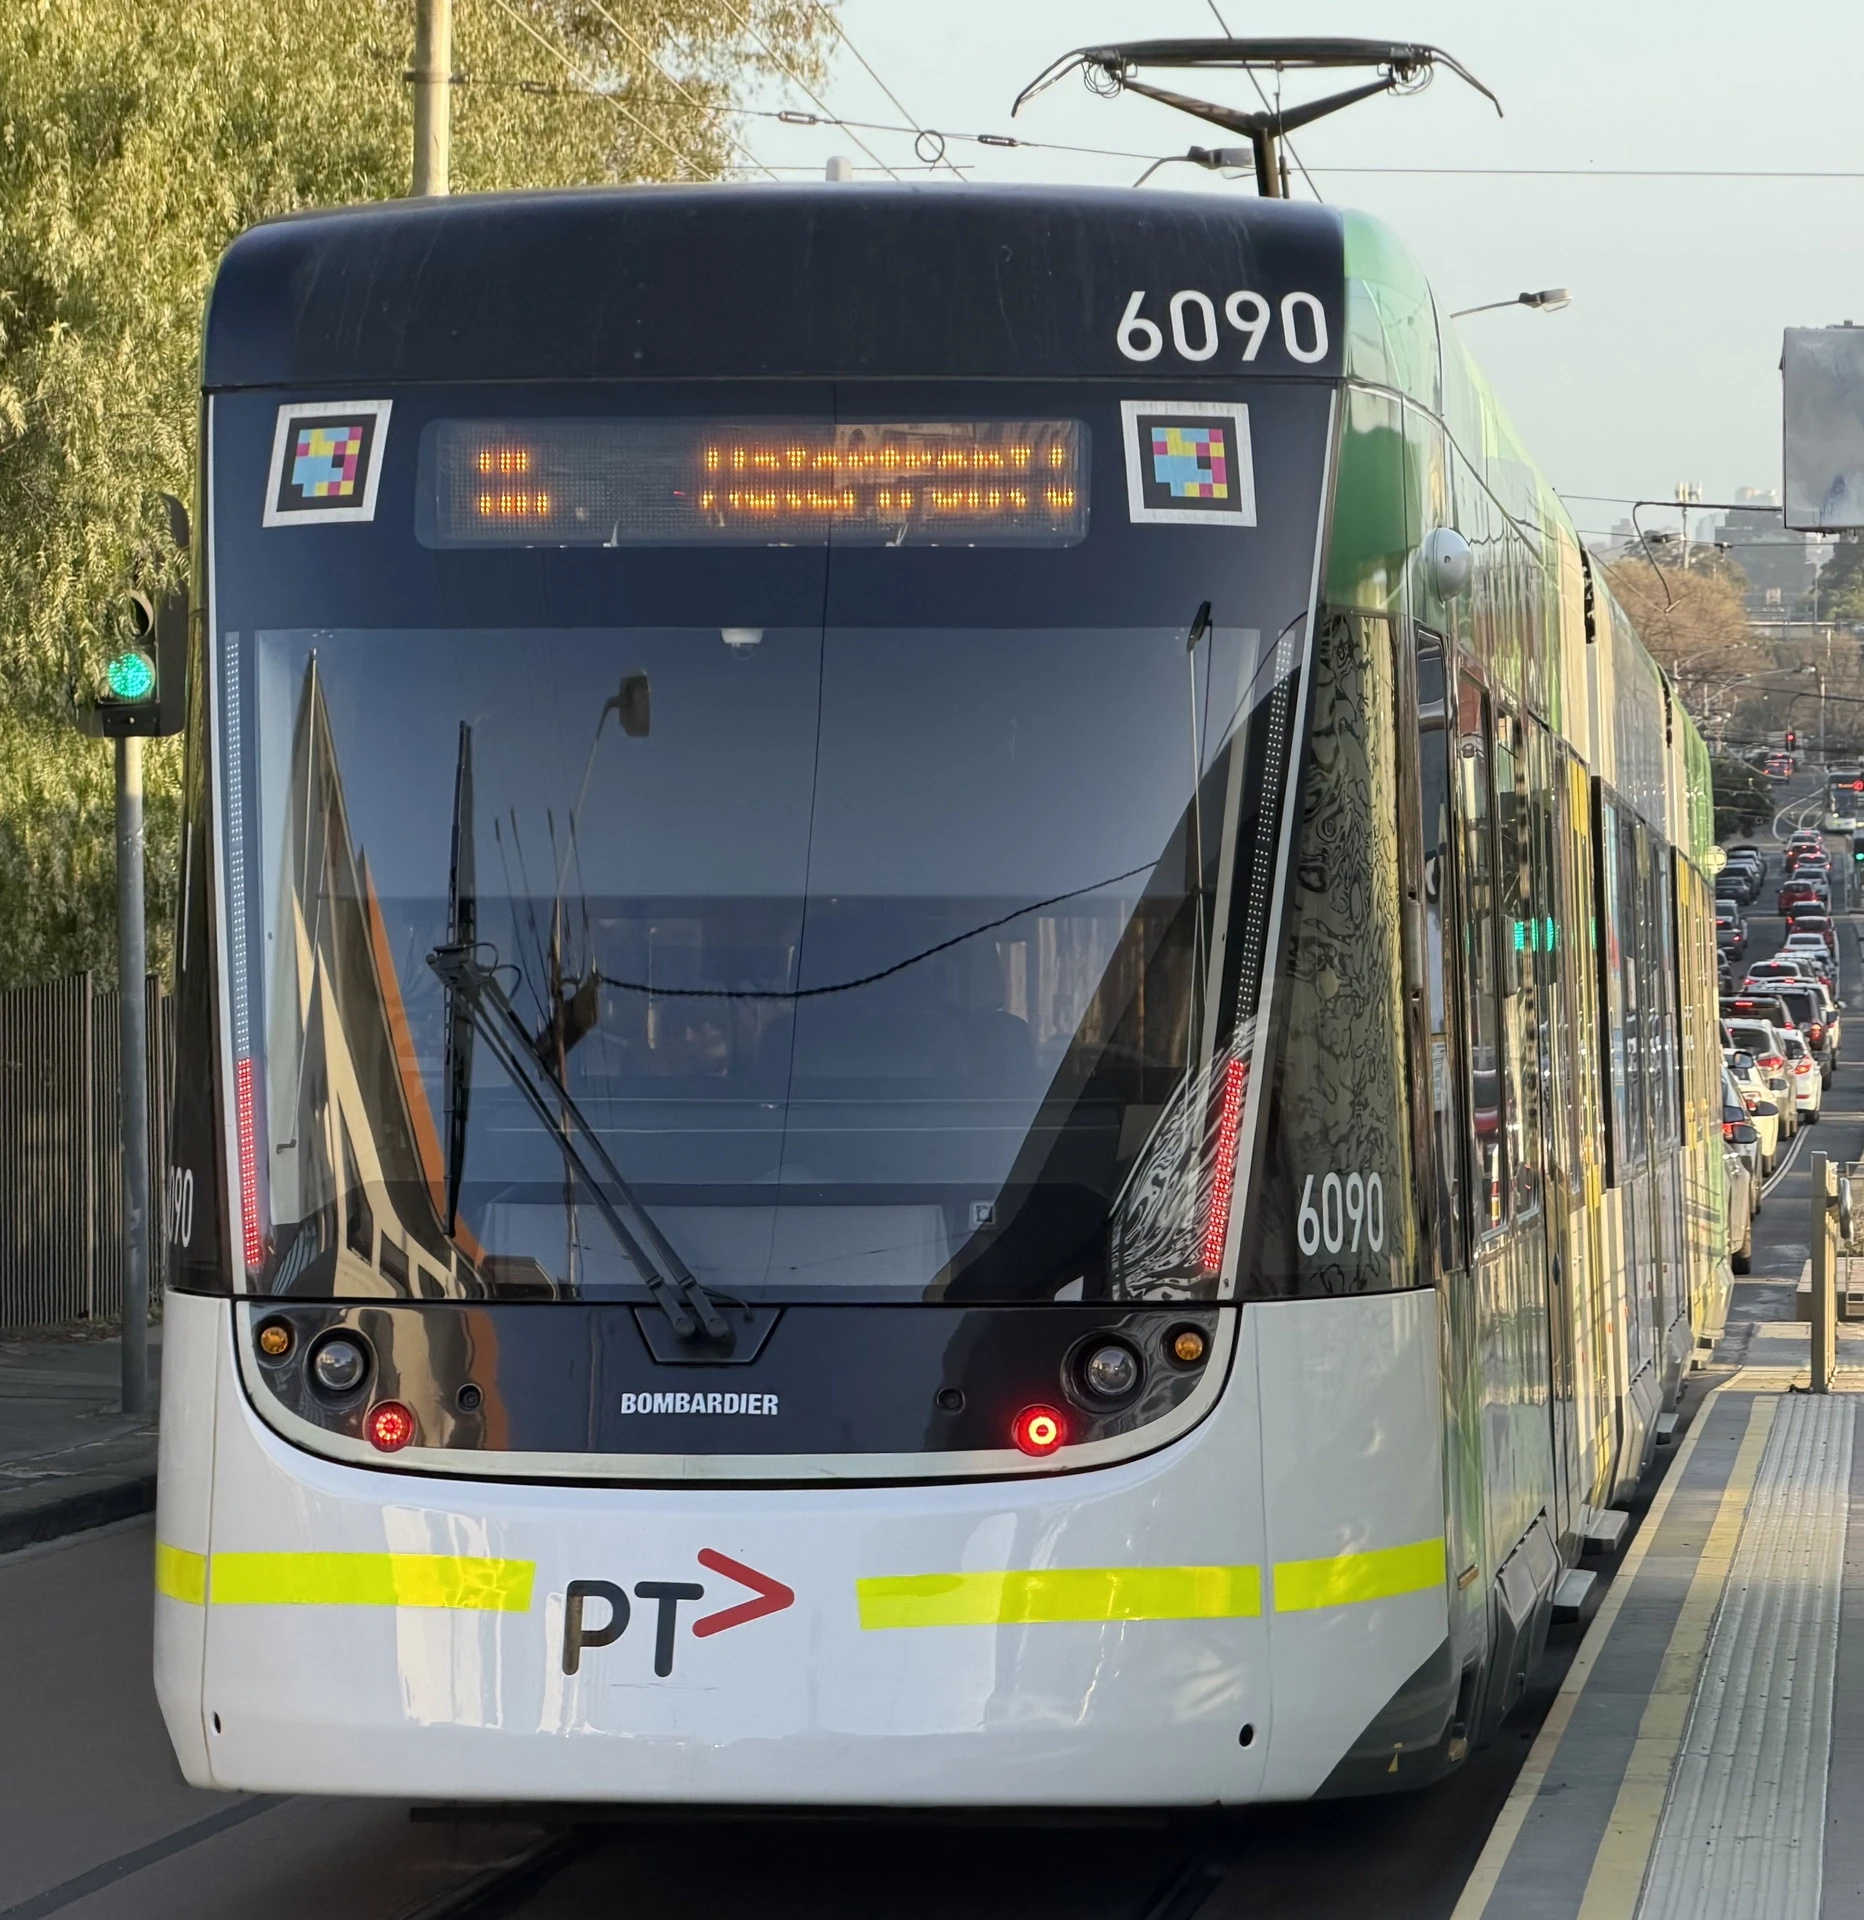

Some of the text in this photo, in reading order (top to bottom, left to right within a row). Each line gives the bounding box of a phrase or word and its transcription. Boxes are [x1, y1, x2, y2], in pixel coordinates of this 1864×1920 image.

[1116, 289, 1329, 364] 6090
[166, 1164, 194, 1248] 090
[1297, 1171, 1384, 1256] 6090
[620, 1392, 779, 1415] BOMBARDIER
[562, 1579, 705, 1678] PT
